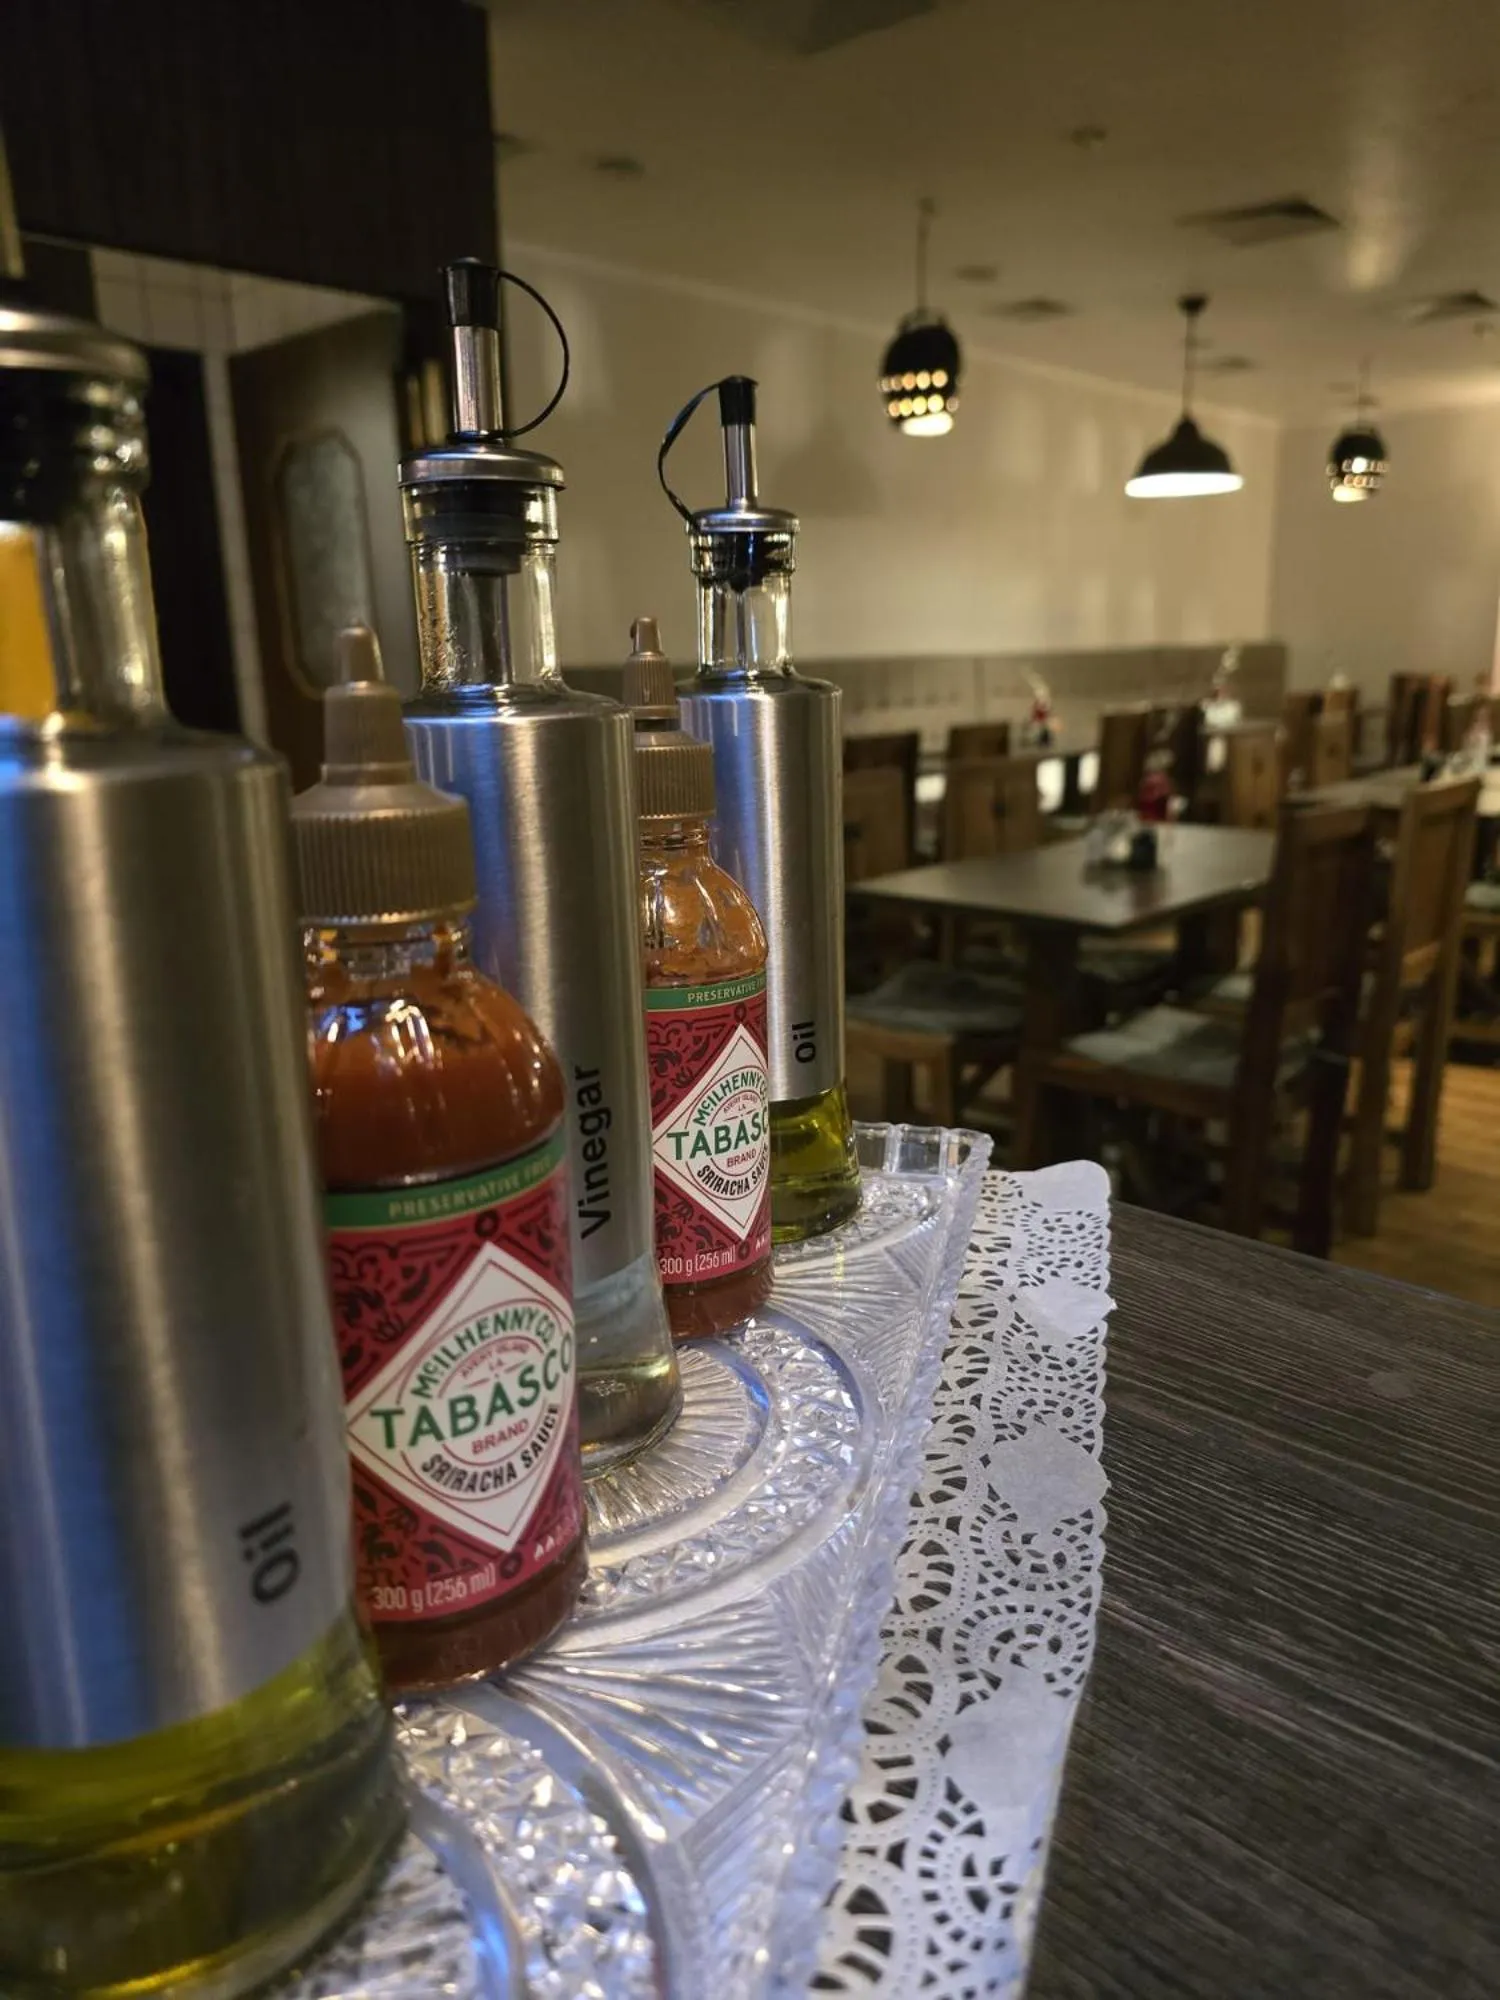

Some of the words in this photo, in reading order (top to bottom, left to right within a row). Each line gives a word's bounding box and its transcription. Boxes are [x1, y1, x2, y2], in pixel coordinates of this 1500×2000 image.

[688, 980, 756, 1003] PRESERVATIVE
[667, 1105, 768, 1160] TABASC
[575, 1065, 611, 1239] Vinegar
[727, 1149, 756, 1168] BRAND
[389, 1173, 520, 1218] PRESERVATIVE
[697, 1165, 750, 1195] SRIRACHA
[660, 1257, 681, 1274] 300
[686, 1258, 693, 1276] g
[370, 1331, 572, 1449] TABASCO
[422, 1454, 518, 1493] SRIRACHA
[521, 1402, 559, 1468] SAUCE
[472, 1418, 529, 1454] BRAND
[372, 1586, 406, 1610] 300
[411, 1588, 424, 1613] g
